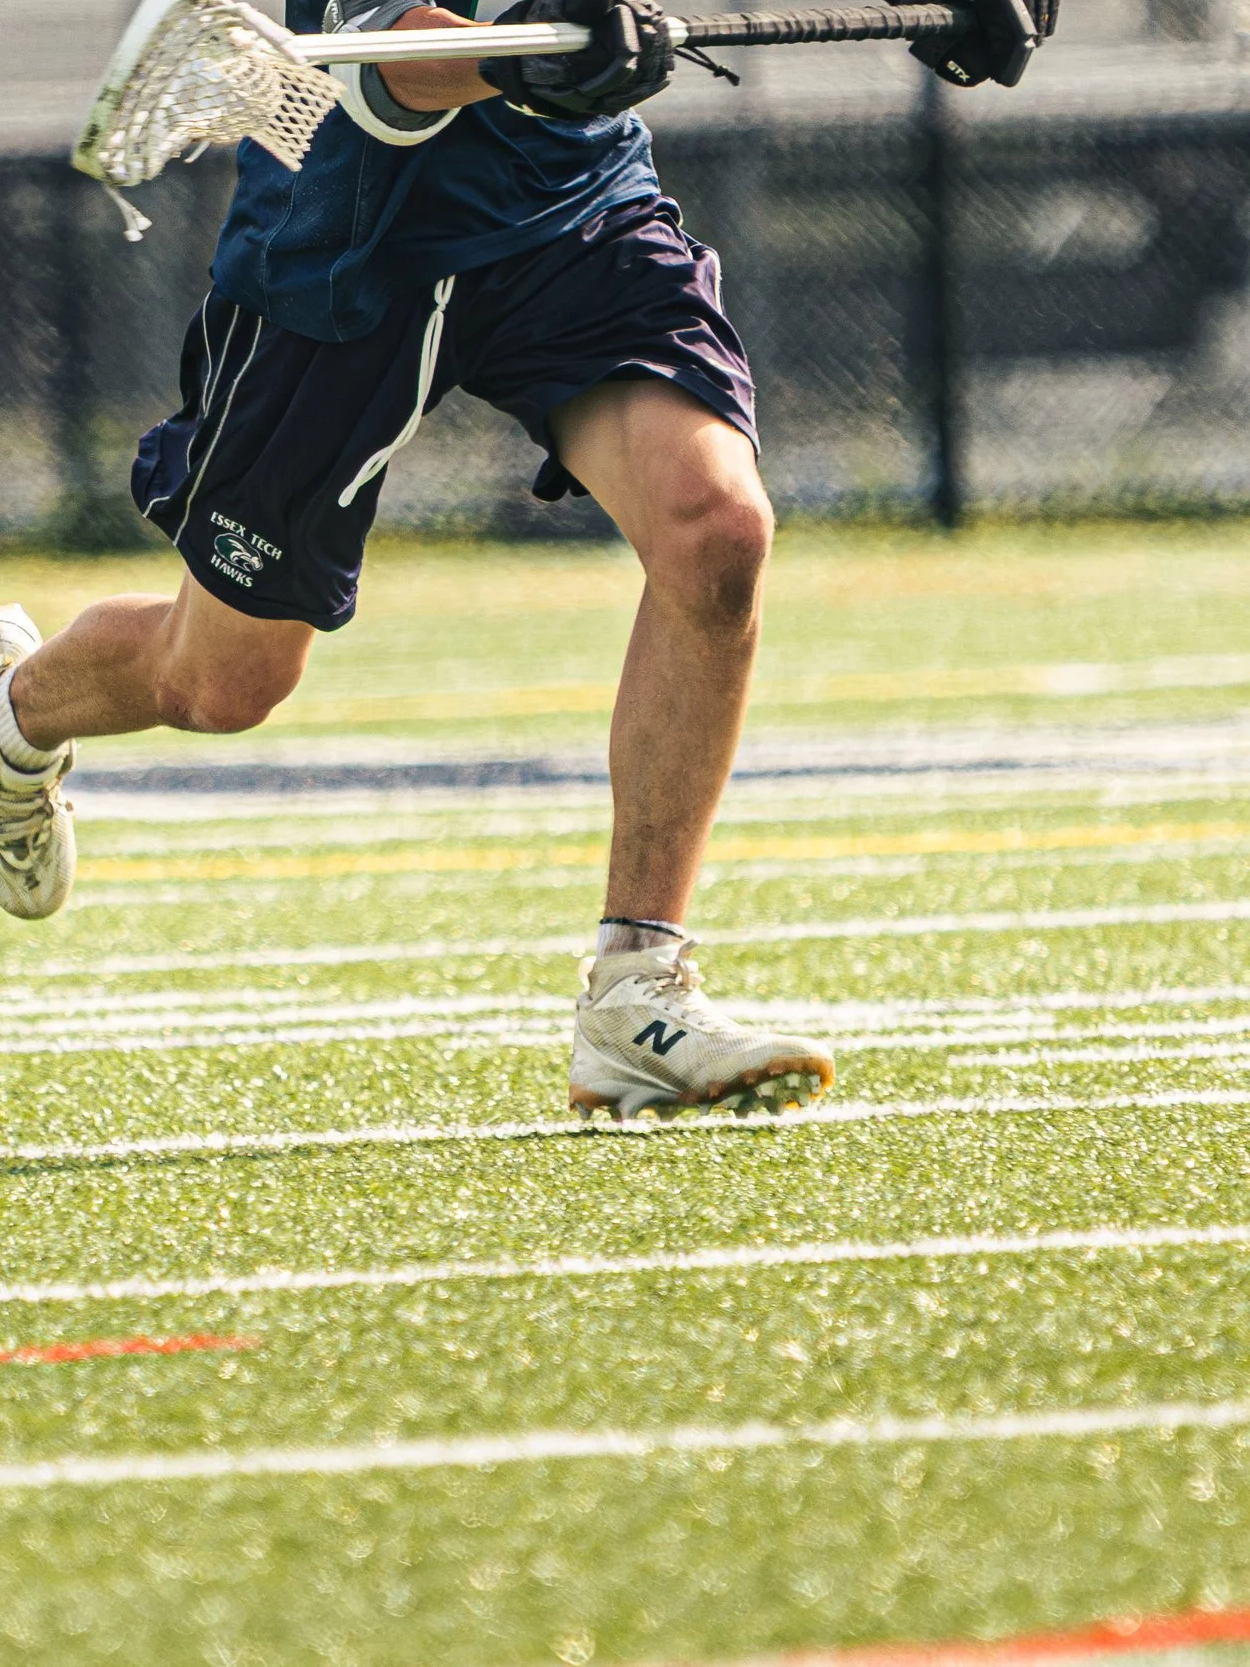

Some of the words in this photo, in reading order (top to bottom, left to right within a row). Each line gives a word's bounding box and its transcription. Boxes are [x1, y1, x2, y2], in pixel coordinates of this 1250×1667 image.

[946, 59, 971, 83] STX
[210, 511, 247, 537] ESSEX
[251, 533, 283, 561] TECH
[210, 554, 253, 588] HAWKS
